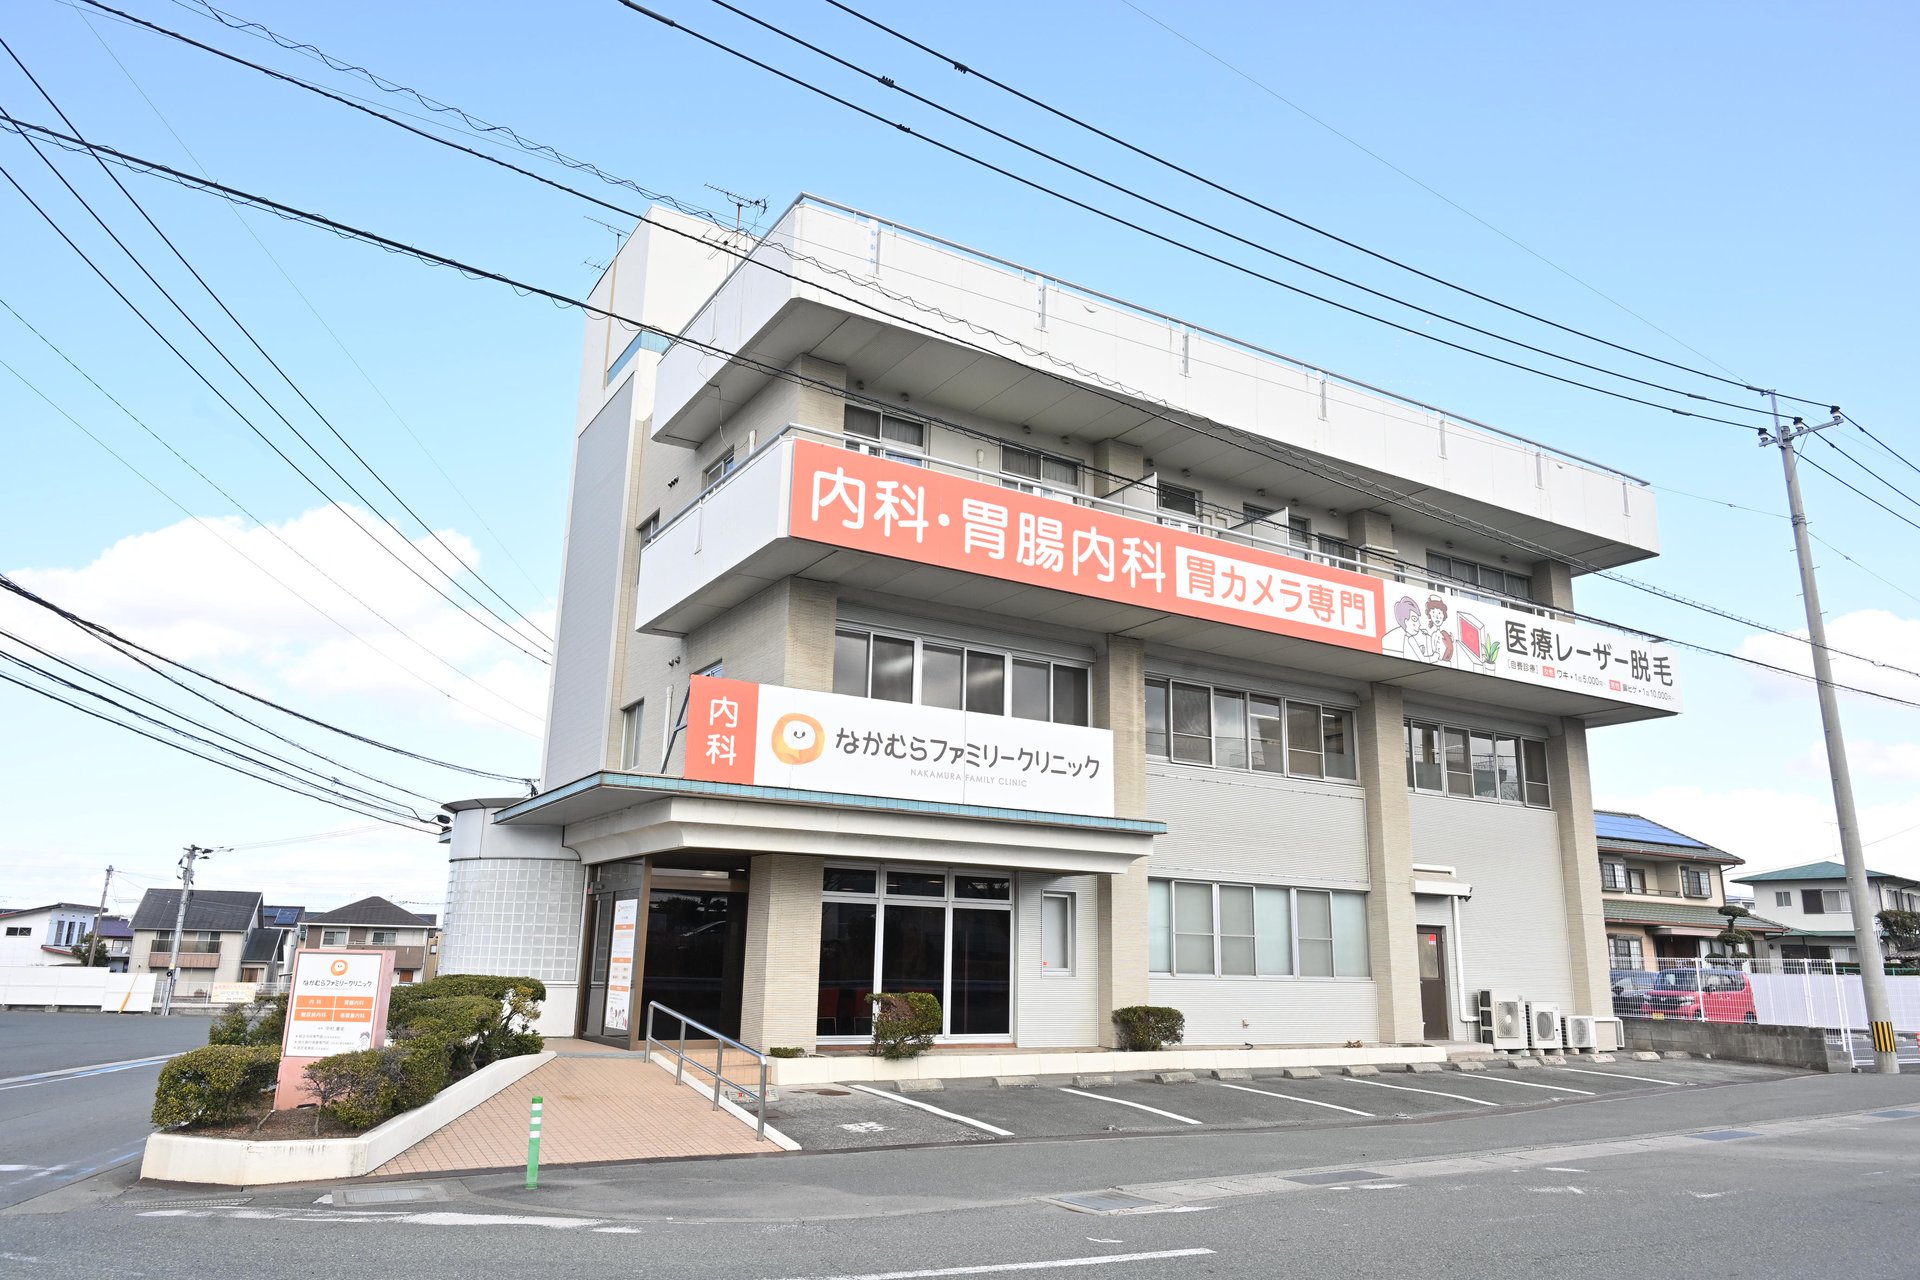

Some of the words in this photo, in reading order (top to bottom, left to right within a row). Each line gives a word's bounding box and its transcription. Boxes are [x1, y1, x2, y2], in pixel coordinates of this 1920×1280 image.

[811, 467, 1166, 593] 内科・胃腸内科
[1187, 555, 1367, 629] 胃カメラ専門
[1505, 620, 1674, 687] 医療レーザー脱毛
[706, 696, 738, 766] 内科
[835, 727, 1099, 779] なかむらファミリークリニック
[910, 768, 962, 781] NAKAMURA
[965, 774, 995, 784] FAMILY
[998, 777, 1028, 788] CLINIC
